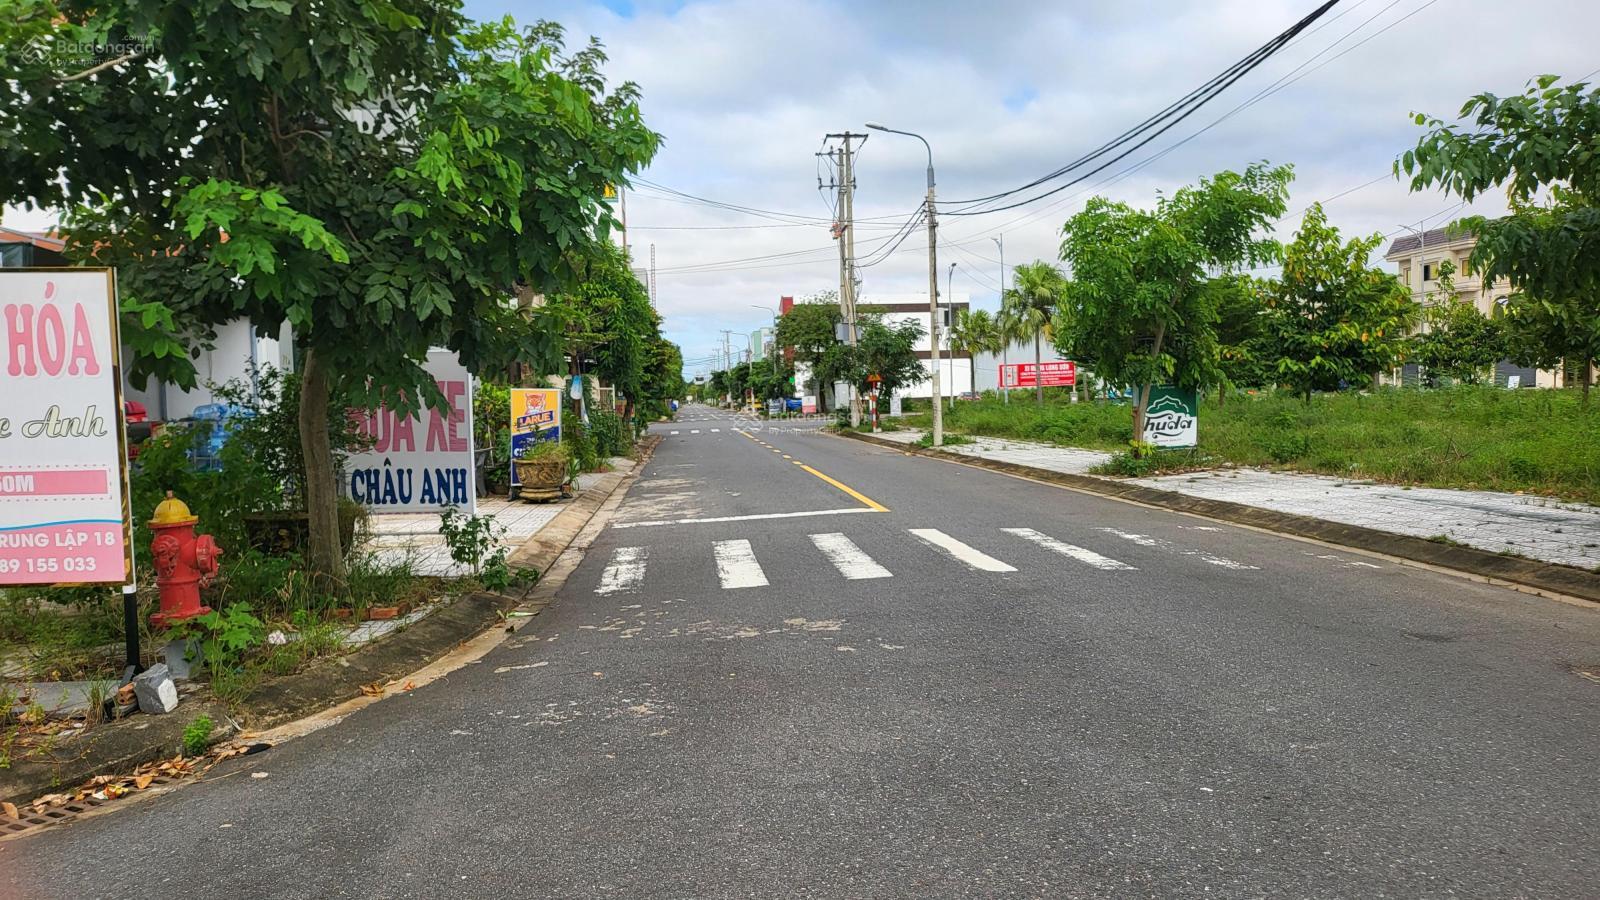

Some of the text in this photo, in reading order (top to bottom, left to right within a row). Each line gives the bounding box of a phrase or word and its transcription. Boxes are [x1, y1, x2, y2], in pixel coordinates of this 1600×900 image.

[4, 281, 100, 376] HÓA
[21, 404, 108, 438] Anh
[518, 411, 551, 426] LARUE
[351, 457, 468, 504] CHÂU ANH
[55, 528, 88, 551] LẬP
[94, 531, 115, 545] 18
[26, 557, 58, 572] 155
[63, 557, 96, 571] 033
